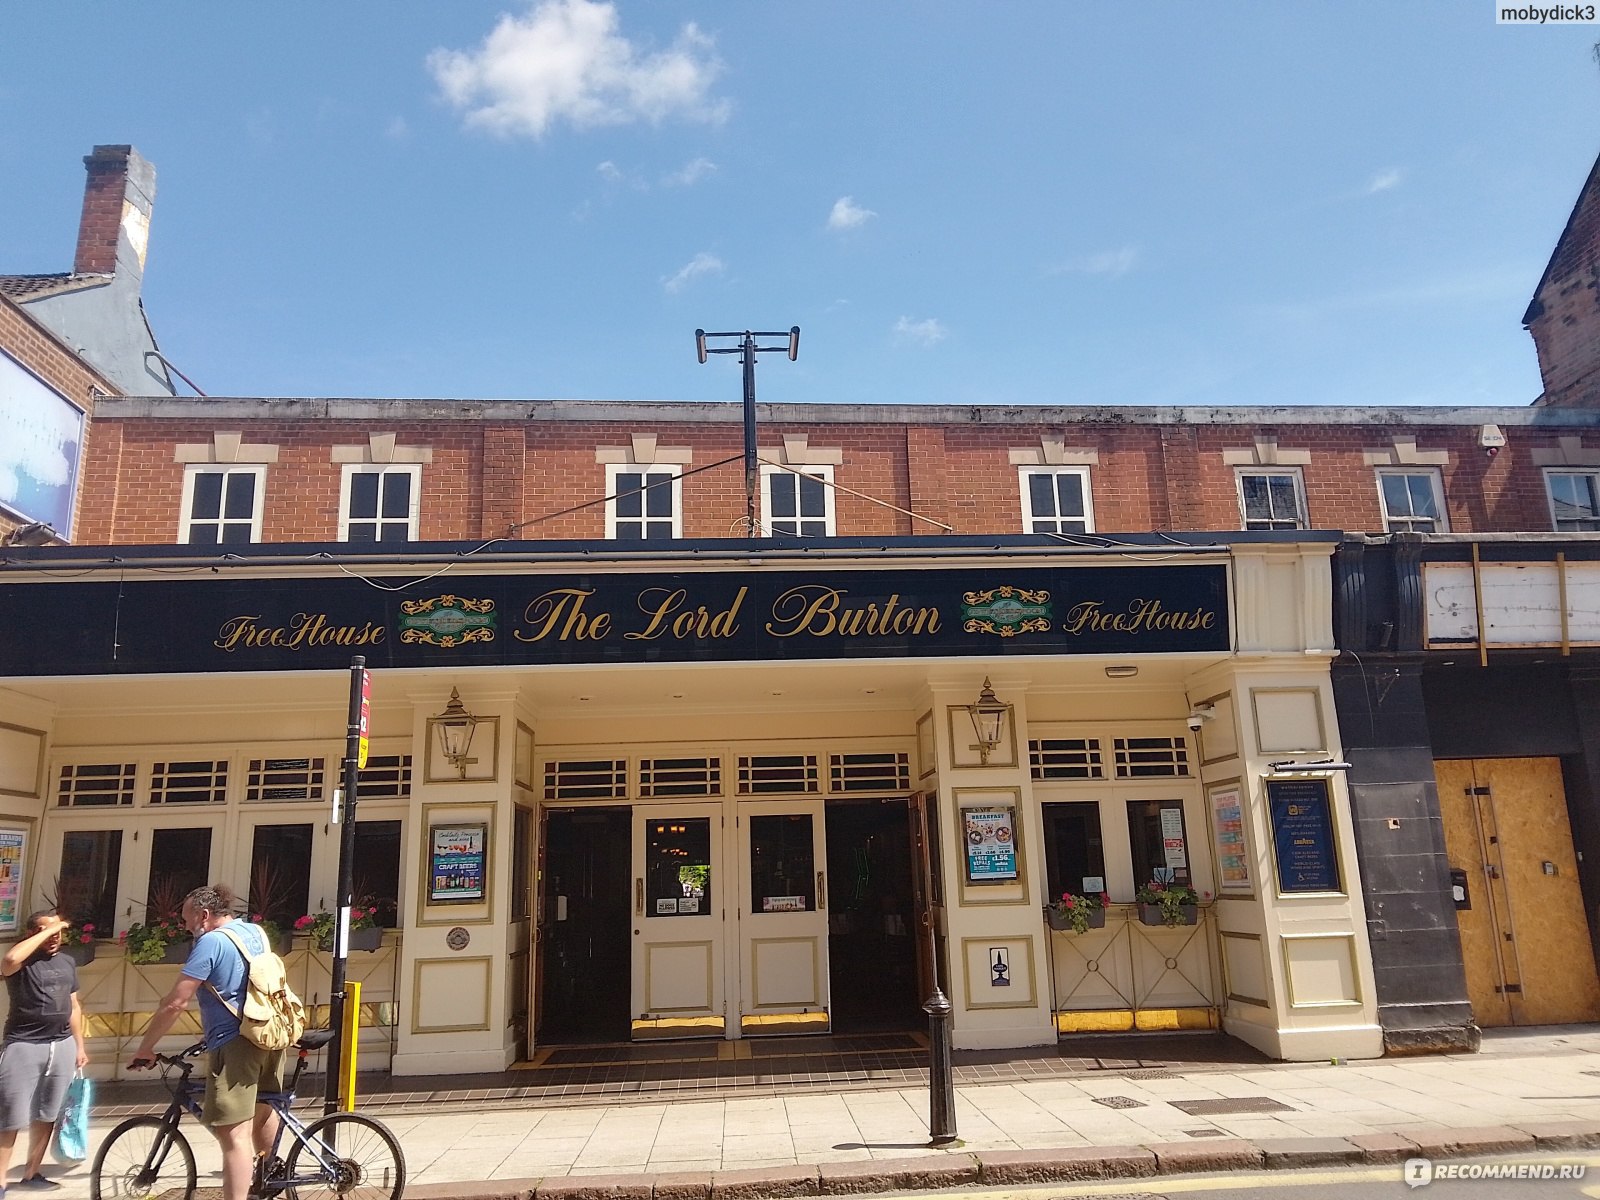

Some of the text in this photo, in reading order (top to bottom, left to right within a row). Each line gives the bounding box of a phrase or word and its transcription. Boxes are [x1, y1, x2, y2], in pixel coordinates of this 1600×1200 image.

[513, 583, 943, 643] The Lord Burton
